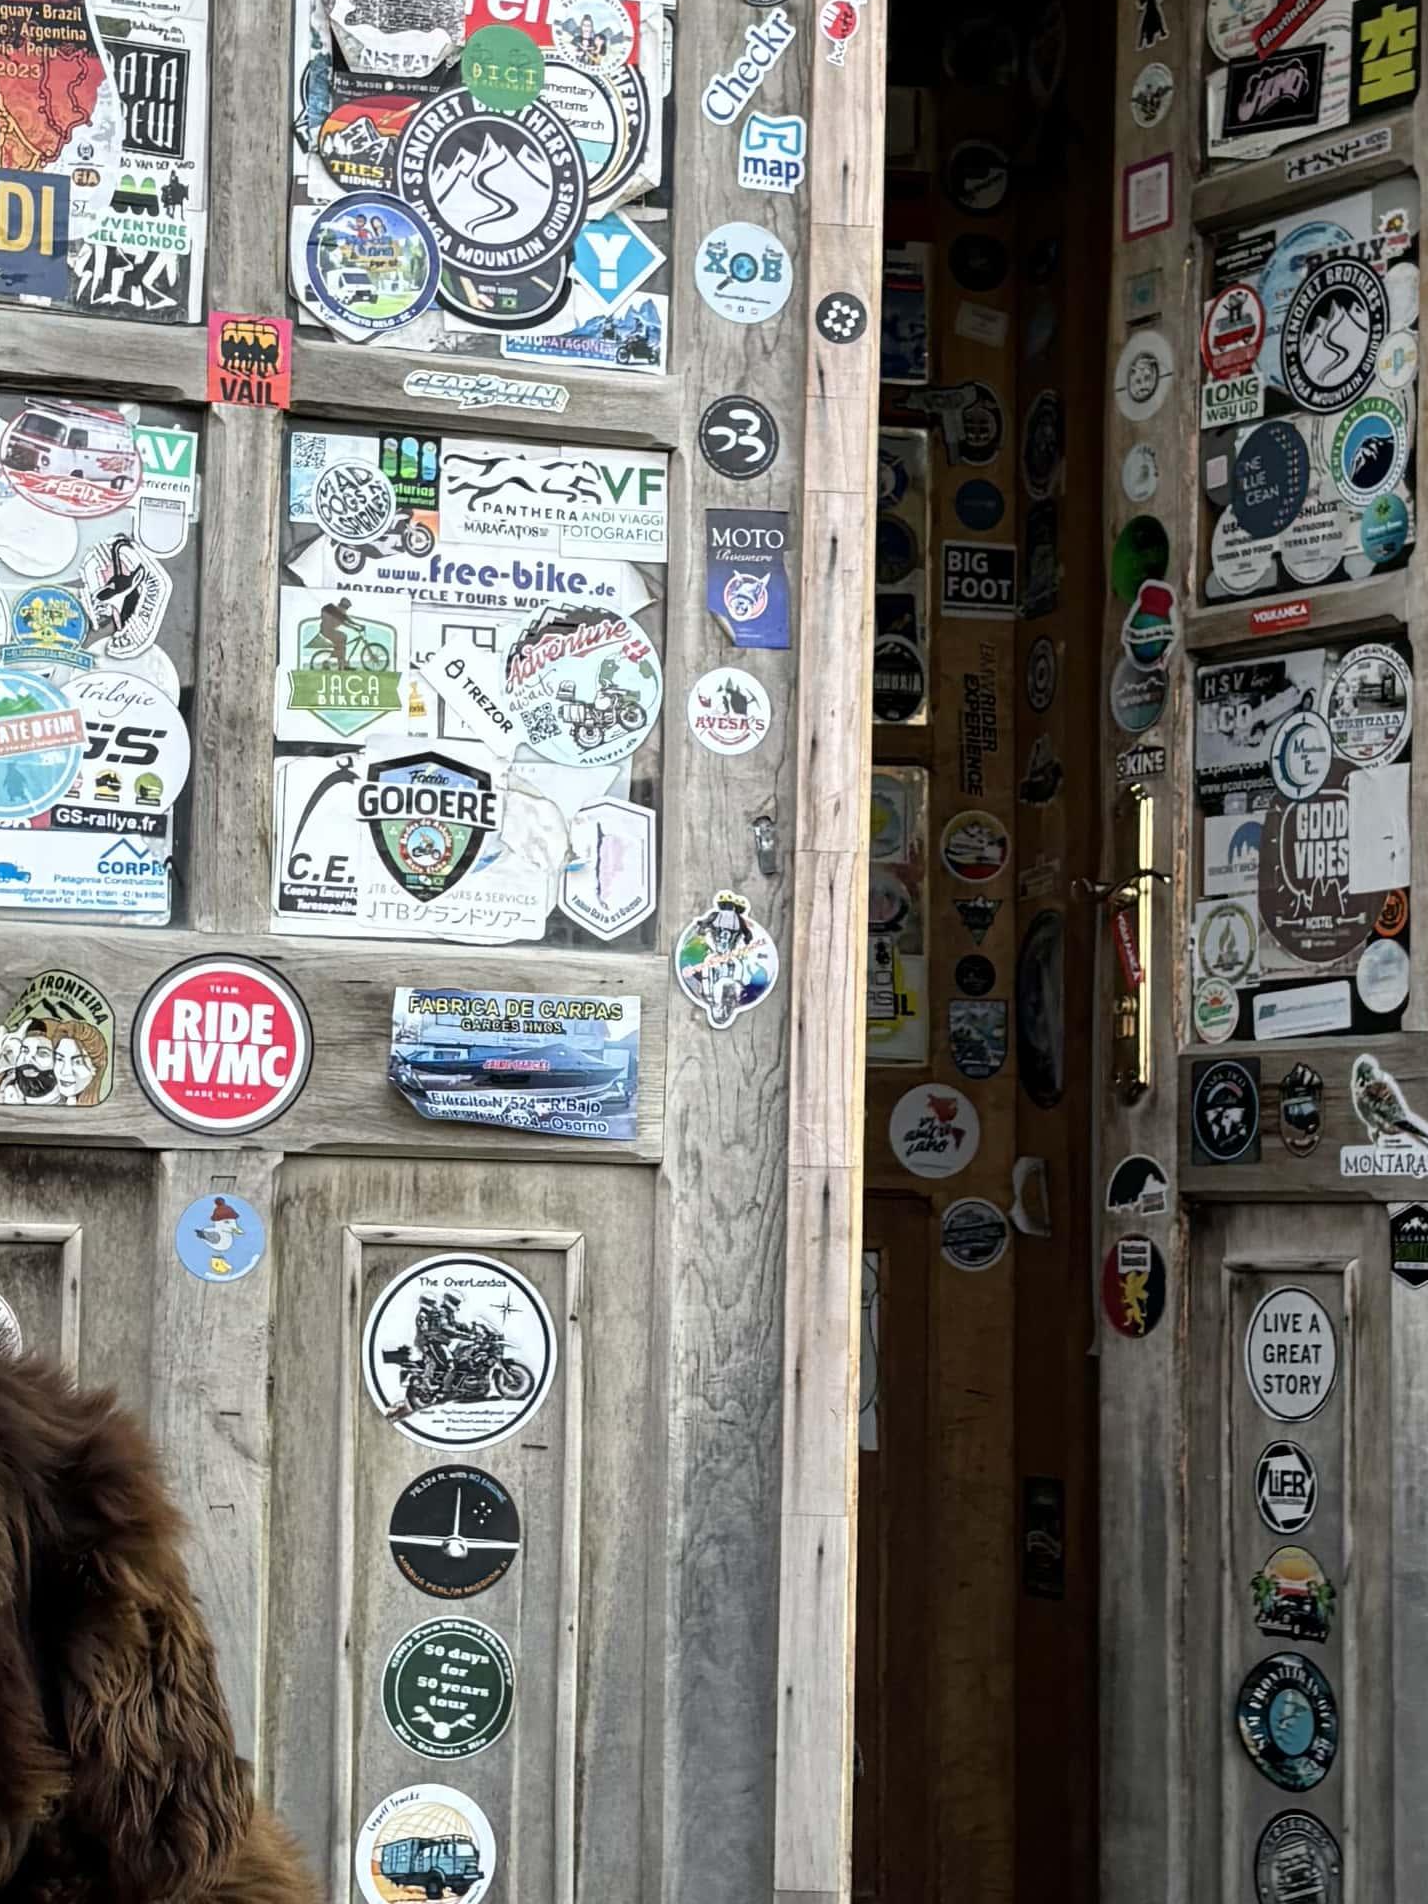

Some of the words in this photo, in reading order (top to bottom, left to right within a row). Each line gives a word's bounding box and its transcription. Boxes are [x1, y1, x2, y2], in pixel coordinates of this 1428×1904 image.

[42, 5, 82, 22] Brazil
[19, 22, 87, 42] Argentina
[24, 40, 58, 58] Peru
[704, 10, 789, 124] Checkr
[402, 101, 464, 185] SENORET
[73, 170, 100, 186] FIA
[330, 159, 389, 179] TRES
[742, 155, 800, 186] map
[456, 240, 544, 270] MOUNTAIN
[542, 182, 575, 242] GUIDES
[121, 234, 187, 252] MONDO
[1288, 279, 1321, 352] SENORET
[1325, 261, 1383, 309] BROTHERS
[219, 377, 277, 406] VAIL
[1206, 376, 1260, 406] LONG
[1205, 402, 1237, 424] way
[1238, 397, 1258, 420] up
[598, 464, 666, 507] VF
[481, 501, 579, 522] PANTHERA
[618, 512, 665, 527] VIAGGI
[561, 524, 665, 544] FOTOGRAFICI
[711, 525, 785, 550] MOTO
[946, 550, 989, 574] BIG
[377, 555, 616, 598] www.free-bike.de
[946, 573, 1013, 599] FOOT
[316, 675, 381, 695] JACA
[1203, 672, 1246, 698] HSV
[76, 683, 157, 718] Trilogie
[459, 673, 514, 736] TREZOR
[695, 714, 766, 734] AVESA'S
[55, 807, 157, 831] GS-rallye.fr
[1295, 797, 1348, 841] GOOD
[287, 852, 356, 885] C.E.
[1293, 837, 1349, 882] VIBES
[38, 974, 110, 1028] FRONTEIRA
[407, 996, 500, 1018] FABRICA
[506, 999, 532, 1019] DE
[539, 1001, 624, 1021] CARPAS
[171, 998, 276, 1048] RIDE
[155, 1039, 289, 1088] HVMC
[551, 1116, 608, 1134] Osorno
[1262, 1312, 1302, 1333] LIVE
[1308, 1313, 1321, 1333] A
[1262, 1343, 1322, 1365] GREAT
[1262, 1373, 1322, 1396] STORY
[423, 1643, 445, 1657] 50
[447, 1648, 491, 1667] days
[439, 1663, 469, 1677] for
[416, 1676, 439, 1690] 50
[441, 1681, 491, 1699] years
[428, 1696, 469, 1712] tour
